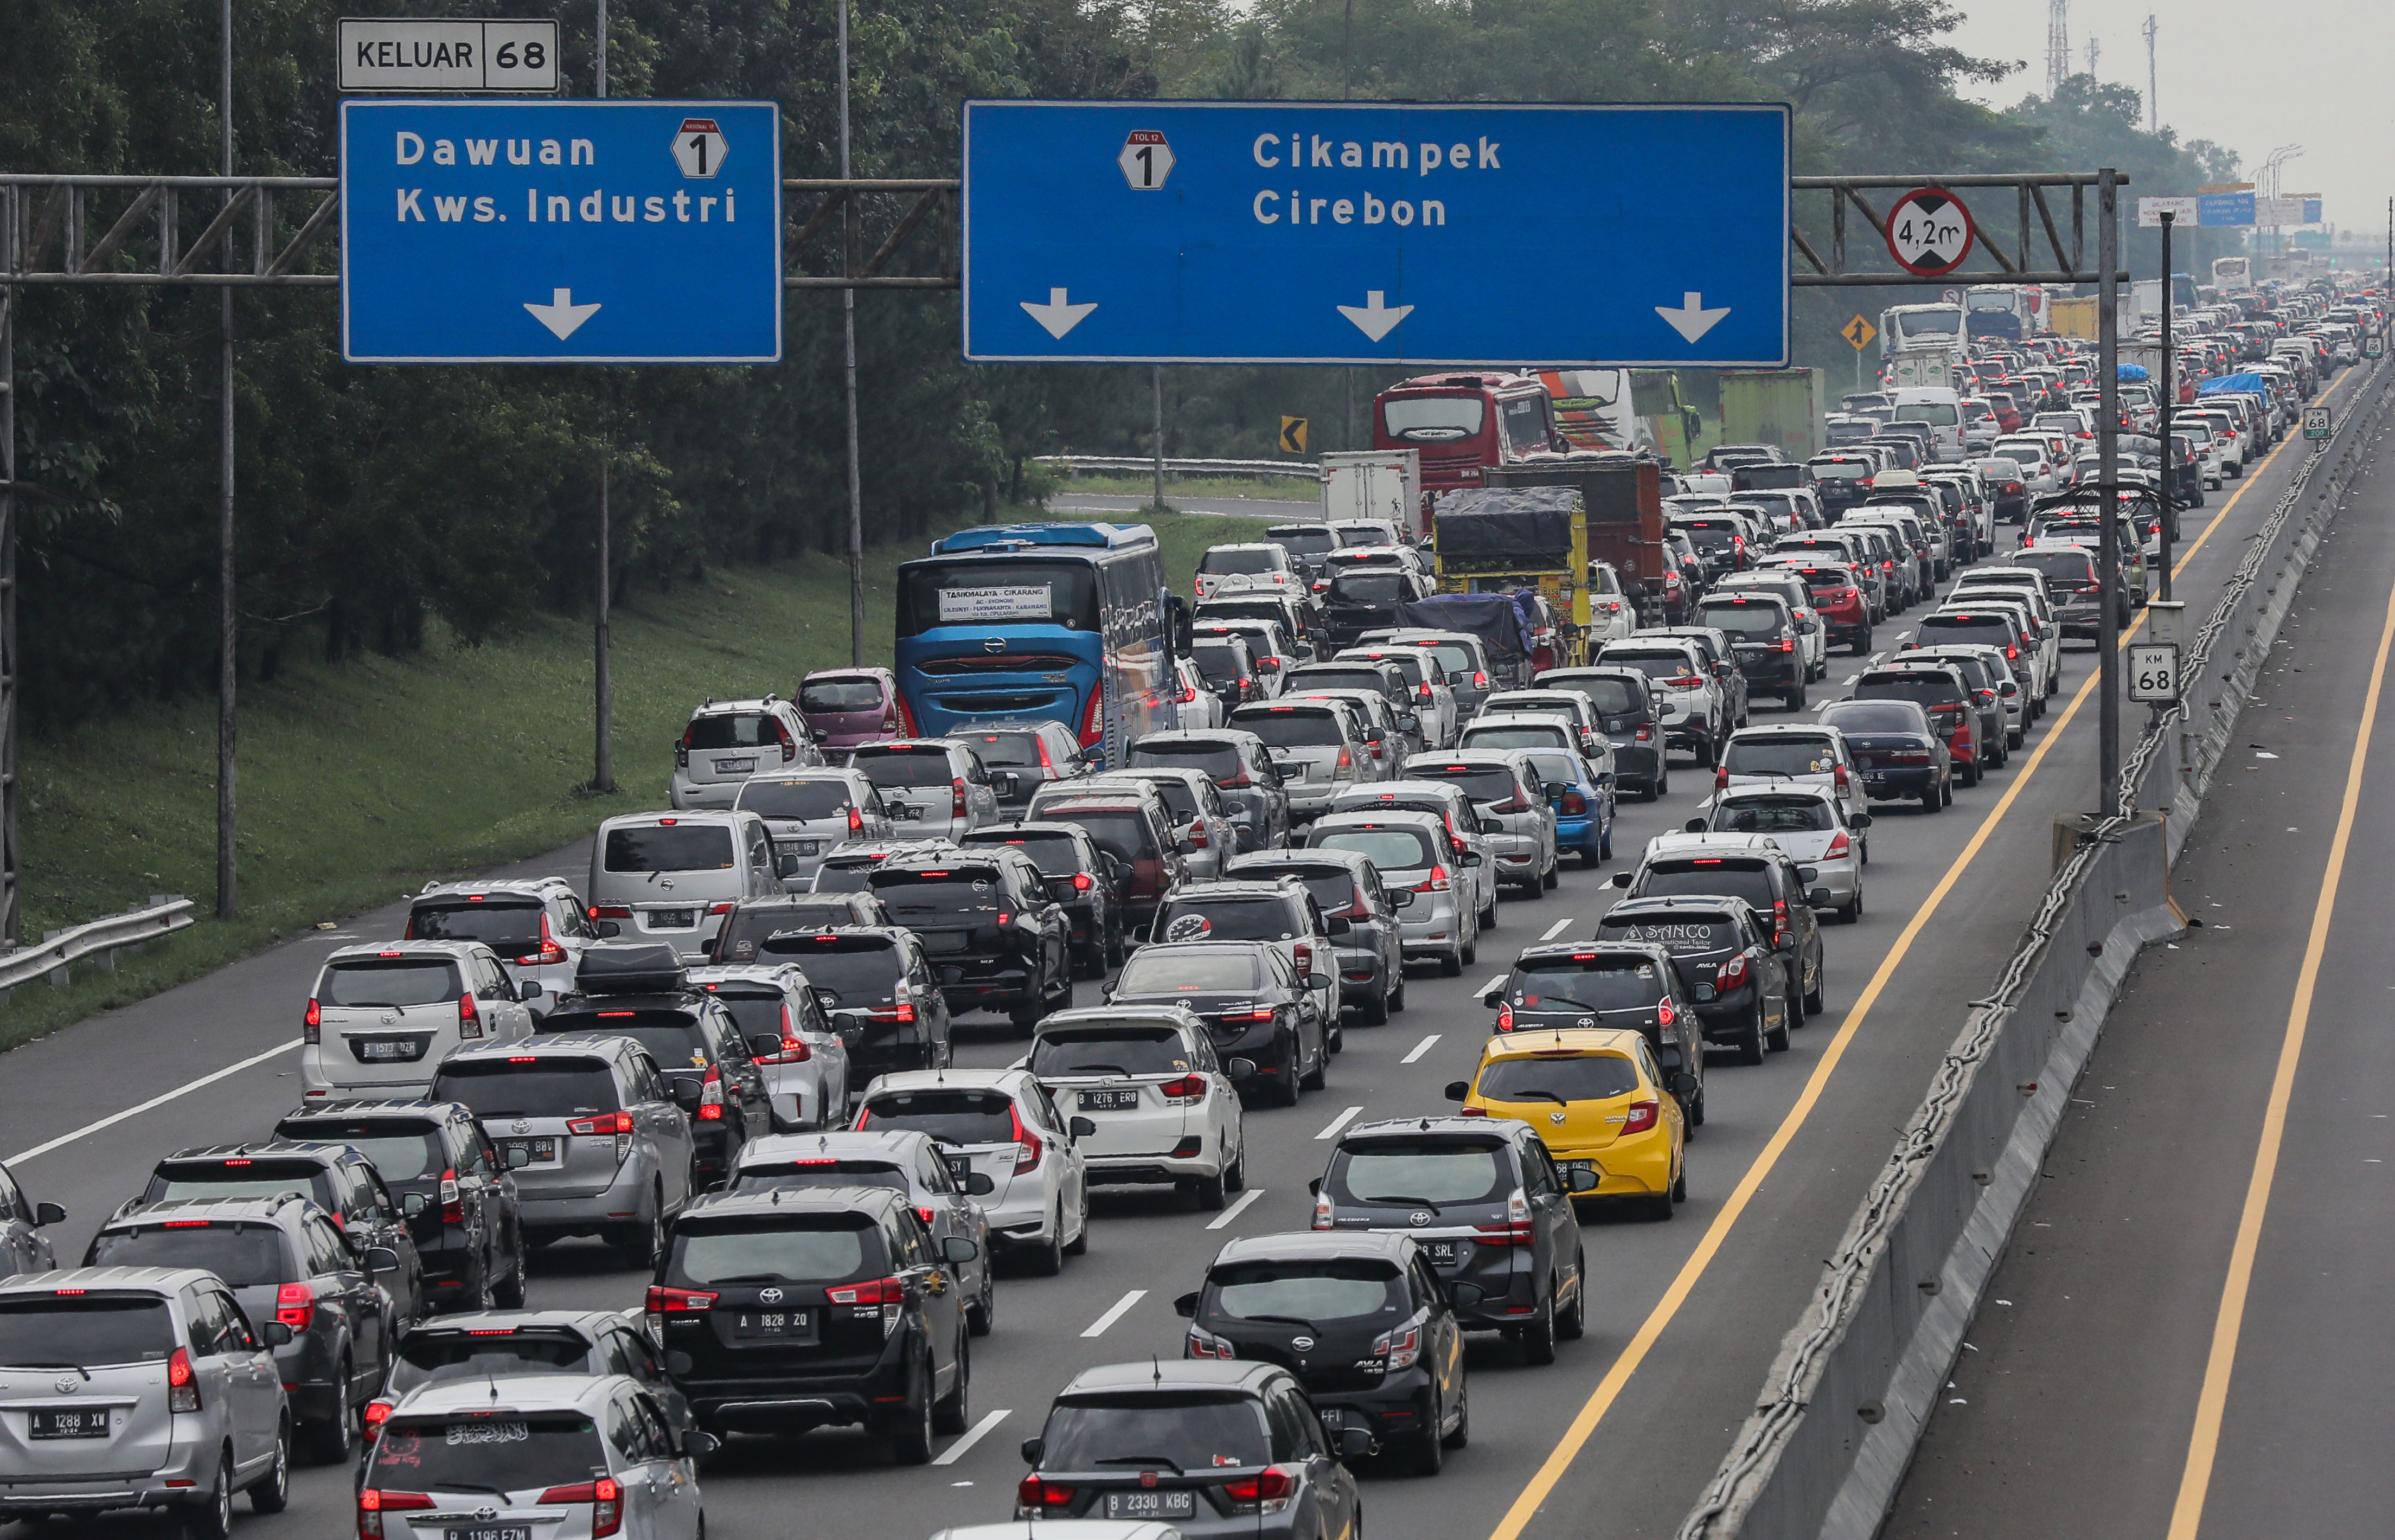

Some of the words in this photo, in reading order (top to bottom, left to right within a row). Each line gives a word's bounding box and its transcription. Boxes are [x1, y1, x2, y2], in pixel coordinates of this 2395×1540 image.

[357, 41, 473, 68] KELUAR
[496, 41, 546, 69] 68
[1134, 133, 1150, 142] TOL
[396, 131, 594, 166] Dawuan
[689, 134, 707, 175] 1
[1253, 133, 1501, 177] Cikampek
[1135, 146, 1152, 187] 1
[396, 189, 507, 222] Kws.
[528, 188, 735, 223] Industri
[1253, 190, 1445, 226] Cirebon
[2368, 343, 2379, 351] 68
[2309, 418, 2325, 428] 68
[946, 589, 998, 599] TASIKMALAYA
[2145, 654, 2162, 664] KM
[2139, 670, 2170, 690] 68
[1645, 924, 1711, 940] SANCO
[1078, 1094, 1084, 1104] B
[1092, 1093, 1112, 1104] 1276
[1435, 1244, 1453, 1257] SRL
[740, 1314, 747, 1327] A
[761, 1314, 784, 1327] 1828
[34, 1415, 40, 1428] A
[55, 1414, 81, 1428] 1288
[91, 1413, 105, 1427] XW
[1110, 1497, 1118, 1510] B
[1128, 1495, 1158, 1510] 2330
[1166, 1493, 1189, 1509] KBG
